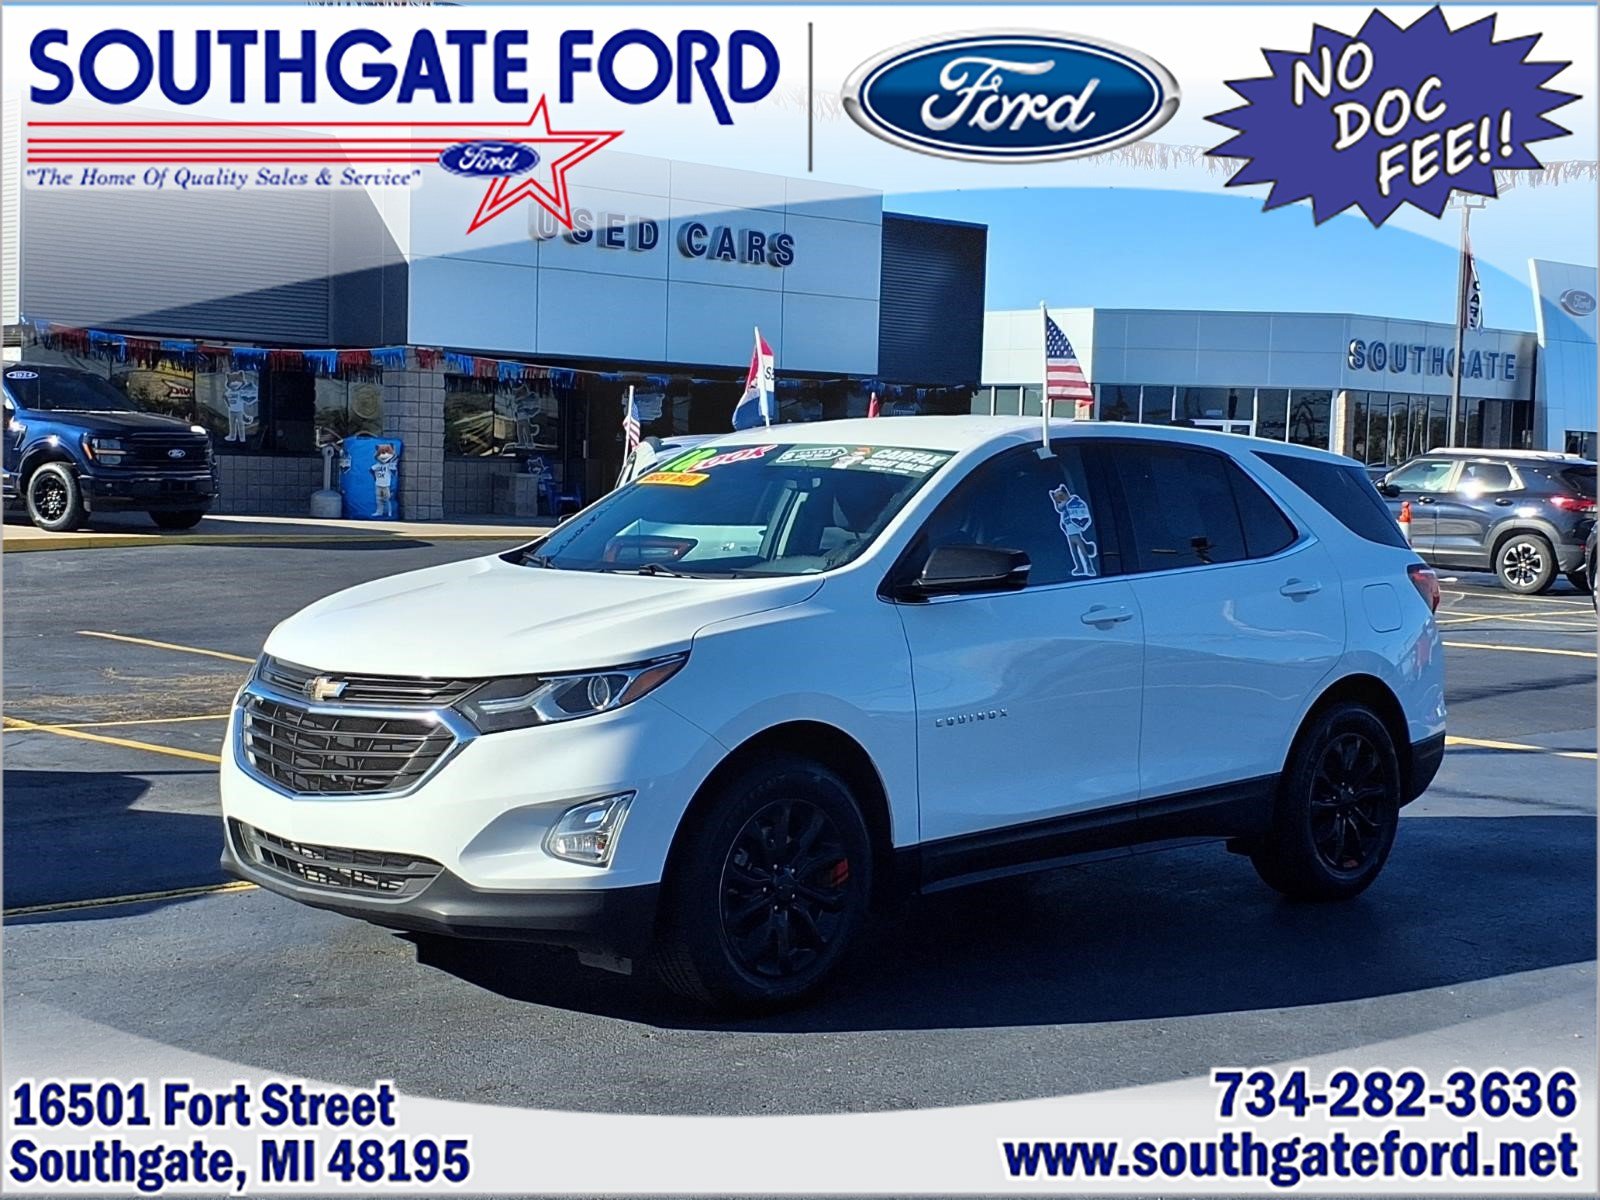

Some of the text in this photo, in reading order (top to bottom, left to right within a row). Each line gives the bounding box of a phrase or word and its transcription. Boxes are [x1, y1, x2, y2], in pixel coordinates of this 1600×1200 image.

[529, 203, 795, 267] USED CARS
[871, 449, 947, 466] CARFAX
[935, 707, 1009, 728] EQUINOX
